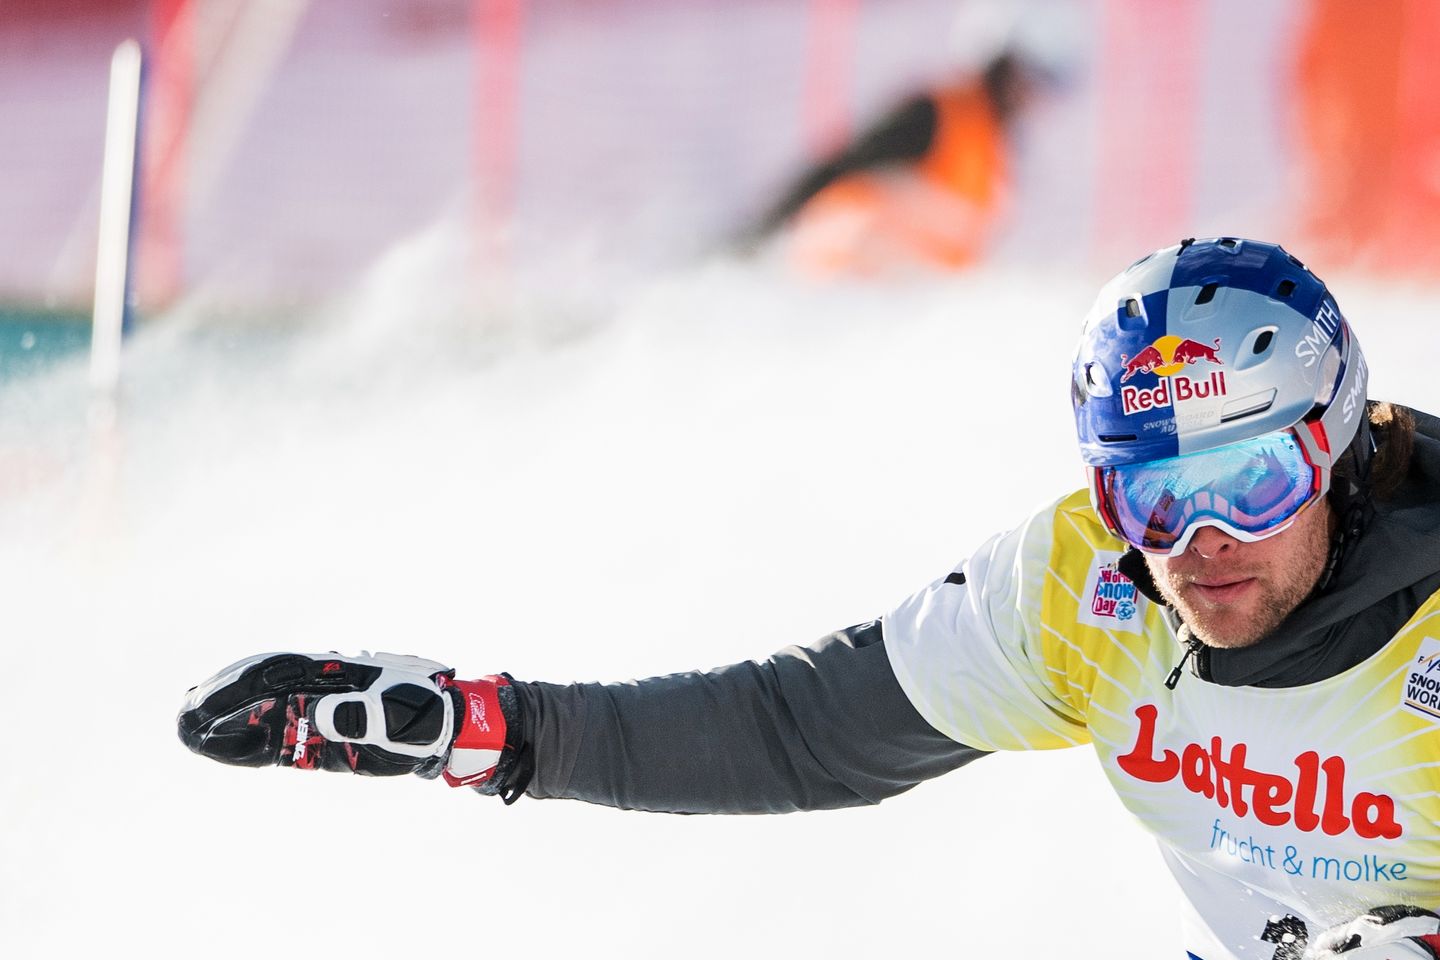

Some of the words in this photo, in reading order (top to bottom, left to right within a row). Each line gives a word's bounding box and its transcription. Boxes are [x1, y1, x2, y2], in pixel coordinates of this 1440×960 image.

[1296, 300, 1339, 367] SMITH
[1123, 379, 1169, 414] Red
[1174, 371, 1226, 401] Bull
[1116, 704, 1403, 839] Lattella
[1210, 819, 1276, 869] frucht
[1282, 845, 1303, 876] &
[1312, 854, 1407, 882] molke
